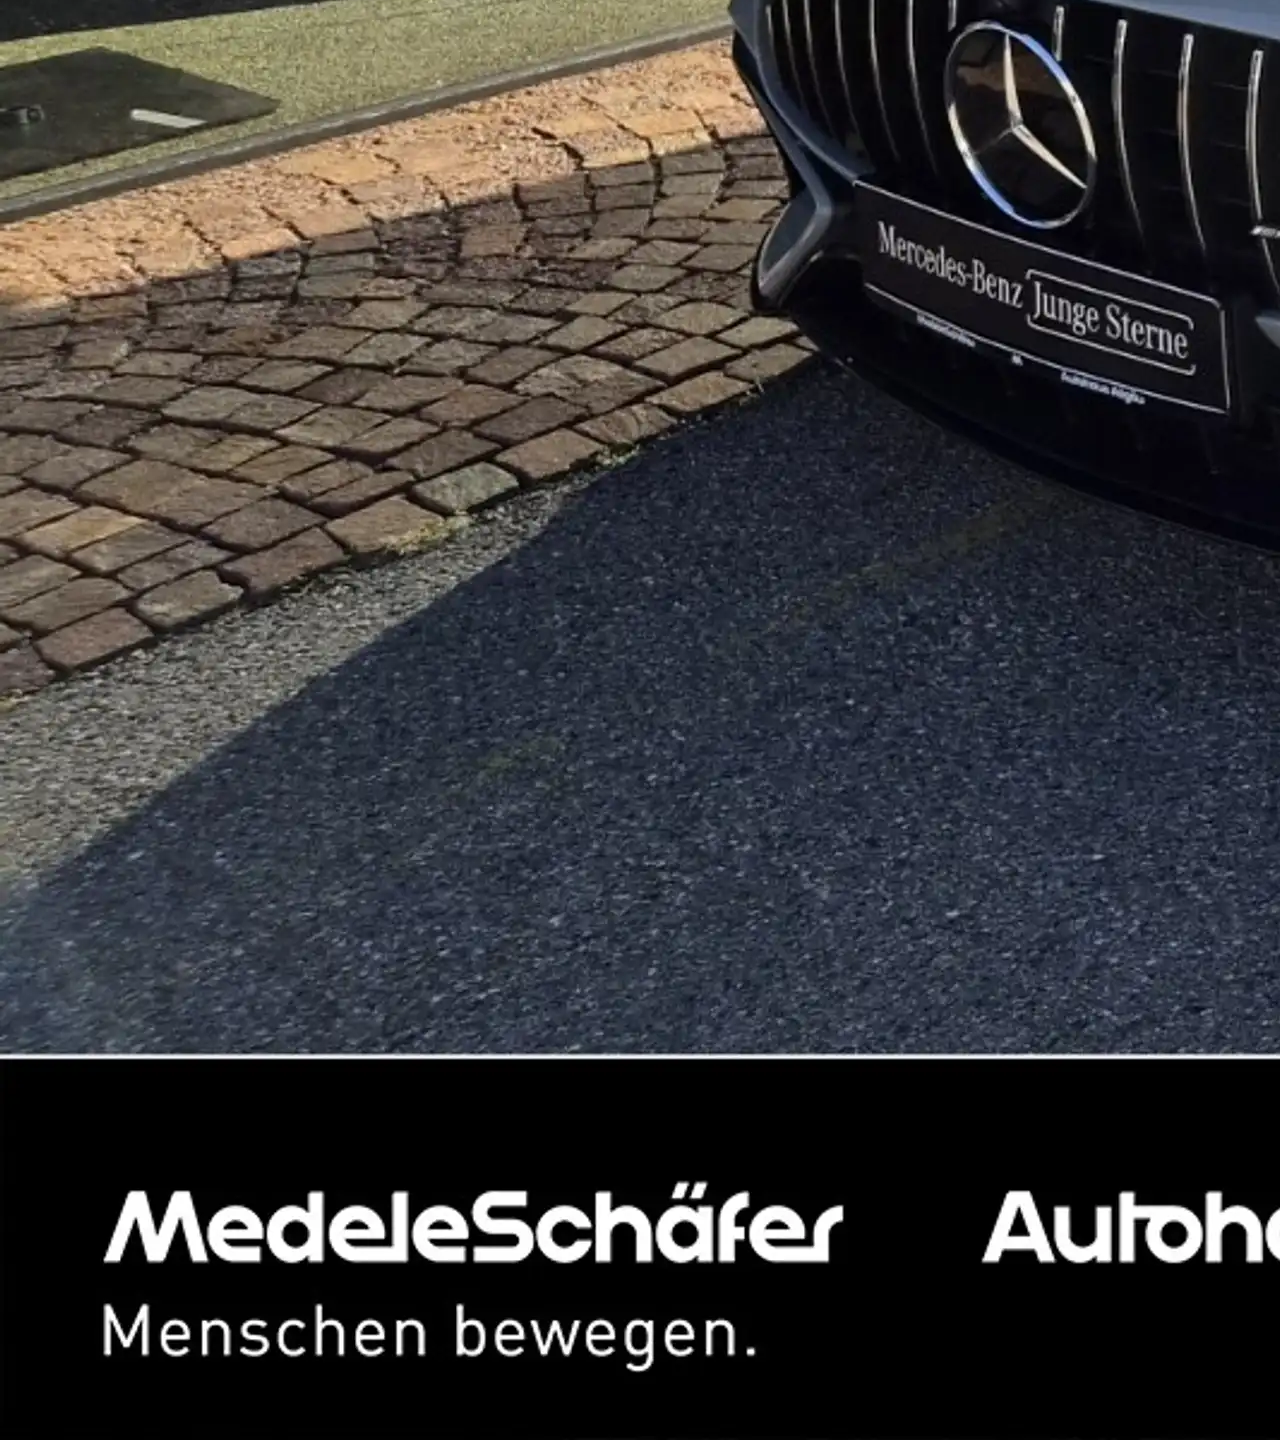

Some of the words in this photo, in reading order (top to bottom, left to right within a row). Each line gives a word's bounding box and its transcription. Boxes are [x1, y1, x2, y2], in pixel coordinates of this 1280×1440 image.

[877, 220, 1024, 309] Mercedes-Benz
[1033, 280, 1100, 336] Junge
[1105, 302, 1189, 359] Sterne
